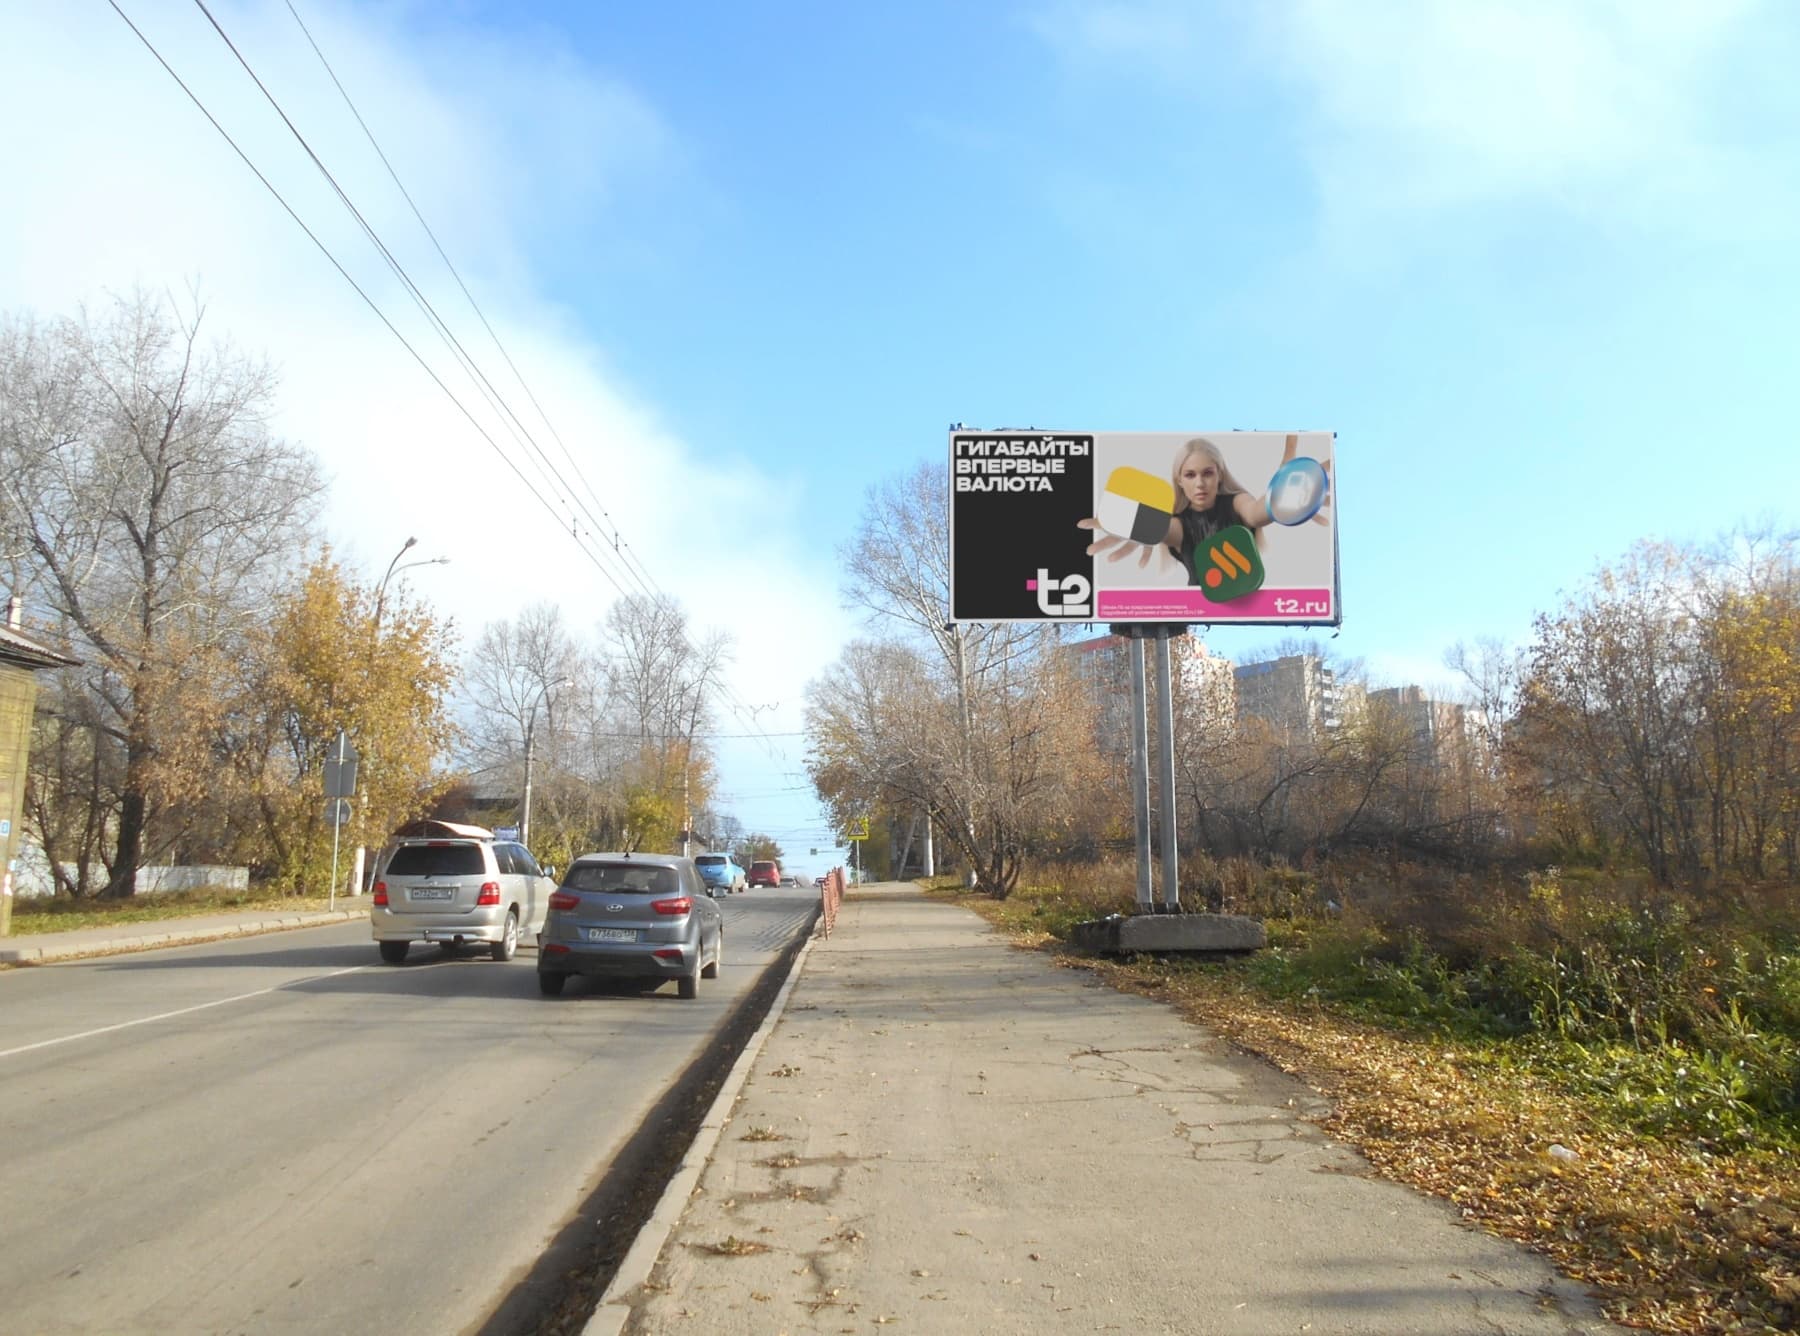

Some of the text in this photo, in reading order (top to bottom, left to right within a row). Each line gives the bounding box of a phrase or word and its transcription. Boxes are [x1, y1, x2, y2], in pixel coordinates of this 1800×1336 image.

[956, 436, 1089, 456] ГИГАБАЙТЫ
[956, 458, 1065, 474] ВПЕРВЫЕ
[956, 476, 1053, 492] ВАЛЮТА
[1026, 568, 1091, 616] t2
[1274, 597, 1327, 613] t2.ru
